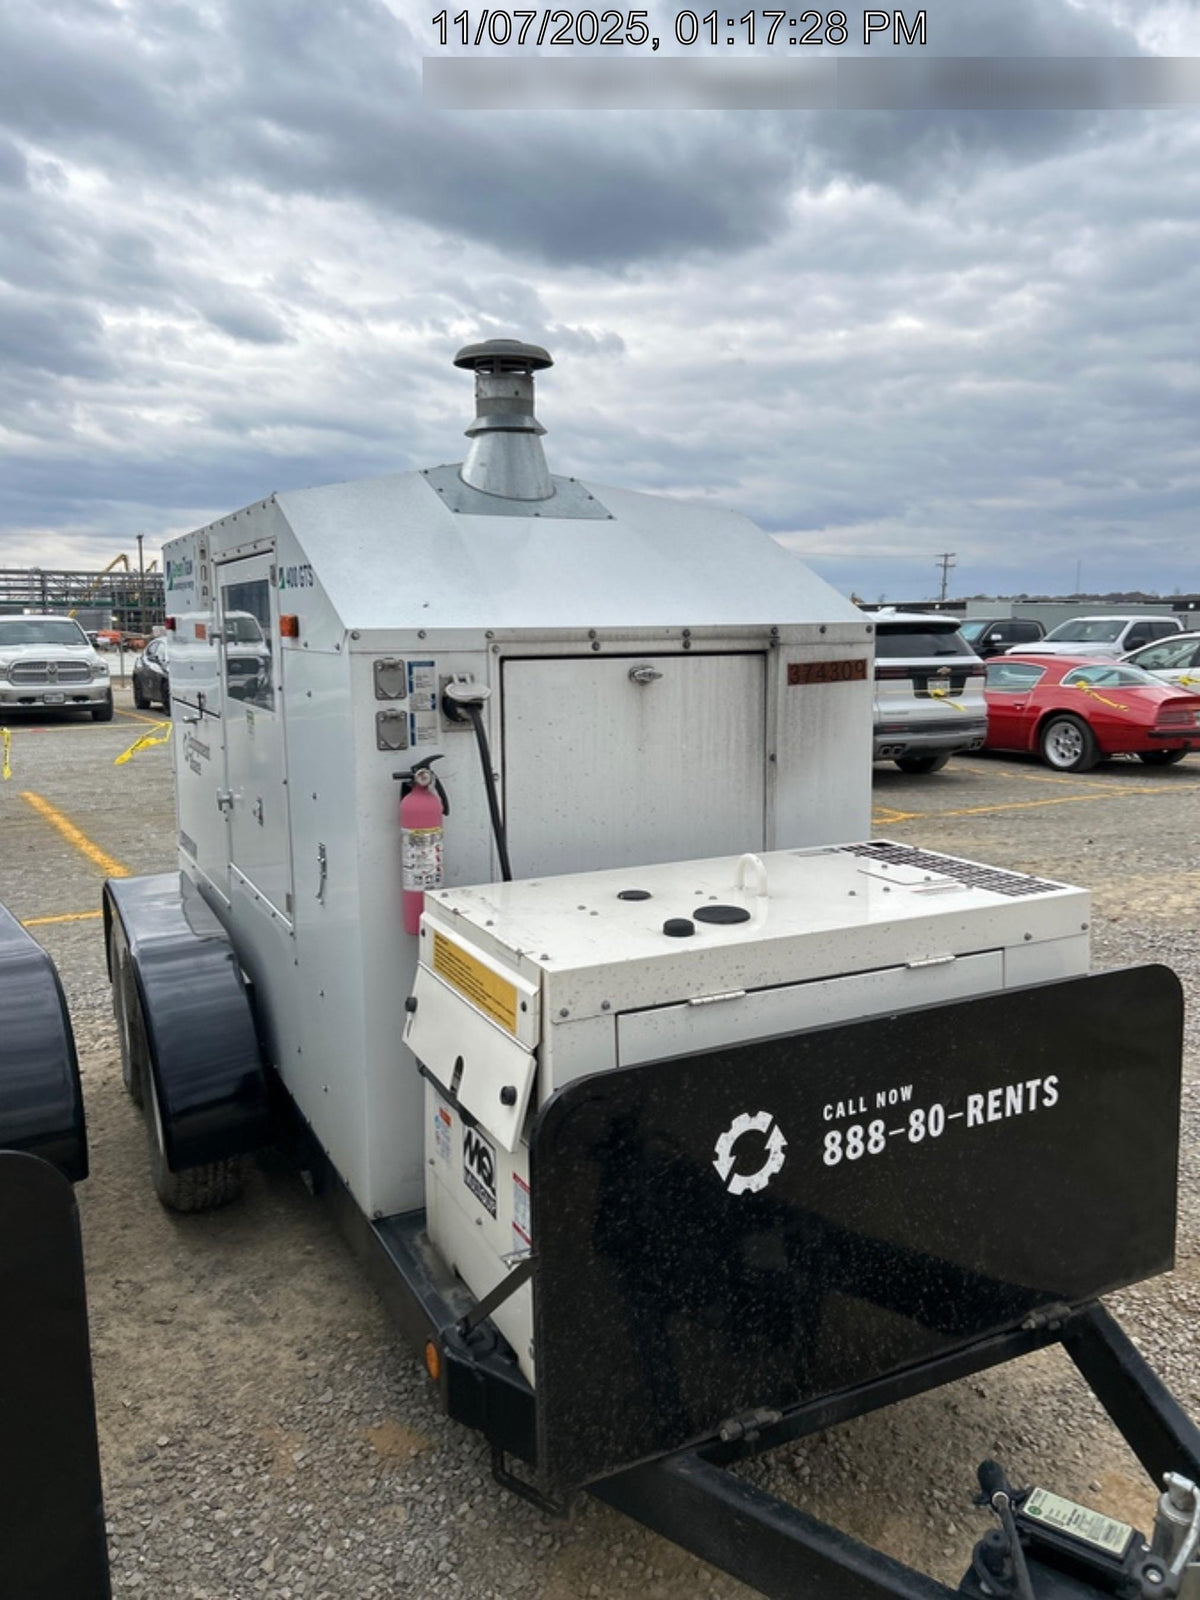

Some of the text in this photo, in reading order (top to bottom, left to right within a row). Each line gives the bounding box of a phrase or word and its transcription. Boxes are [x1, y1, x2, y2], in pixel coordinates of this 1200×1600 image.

[822, 1074, 1060, 1167] 888-80-RENTS
[823, 1084, 914, 1121] CALL NOW
